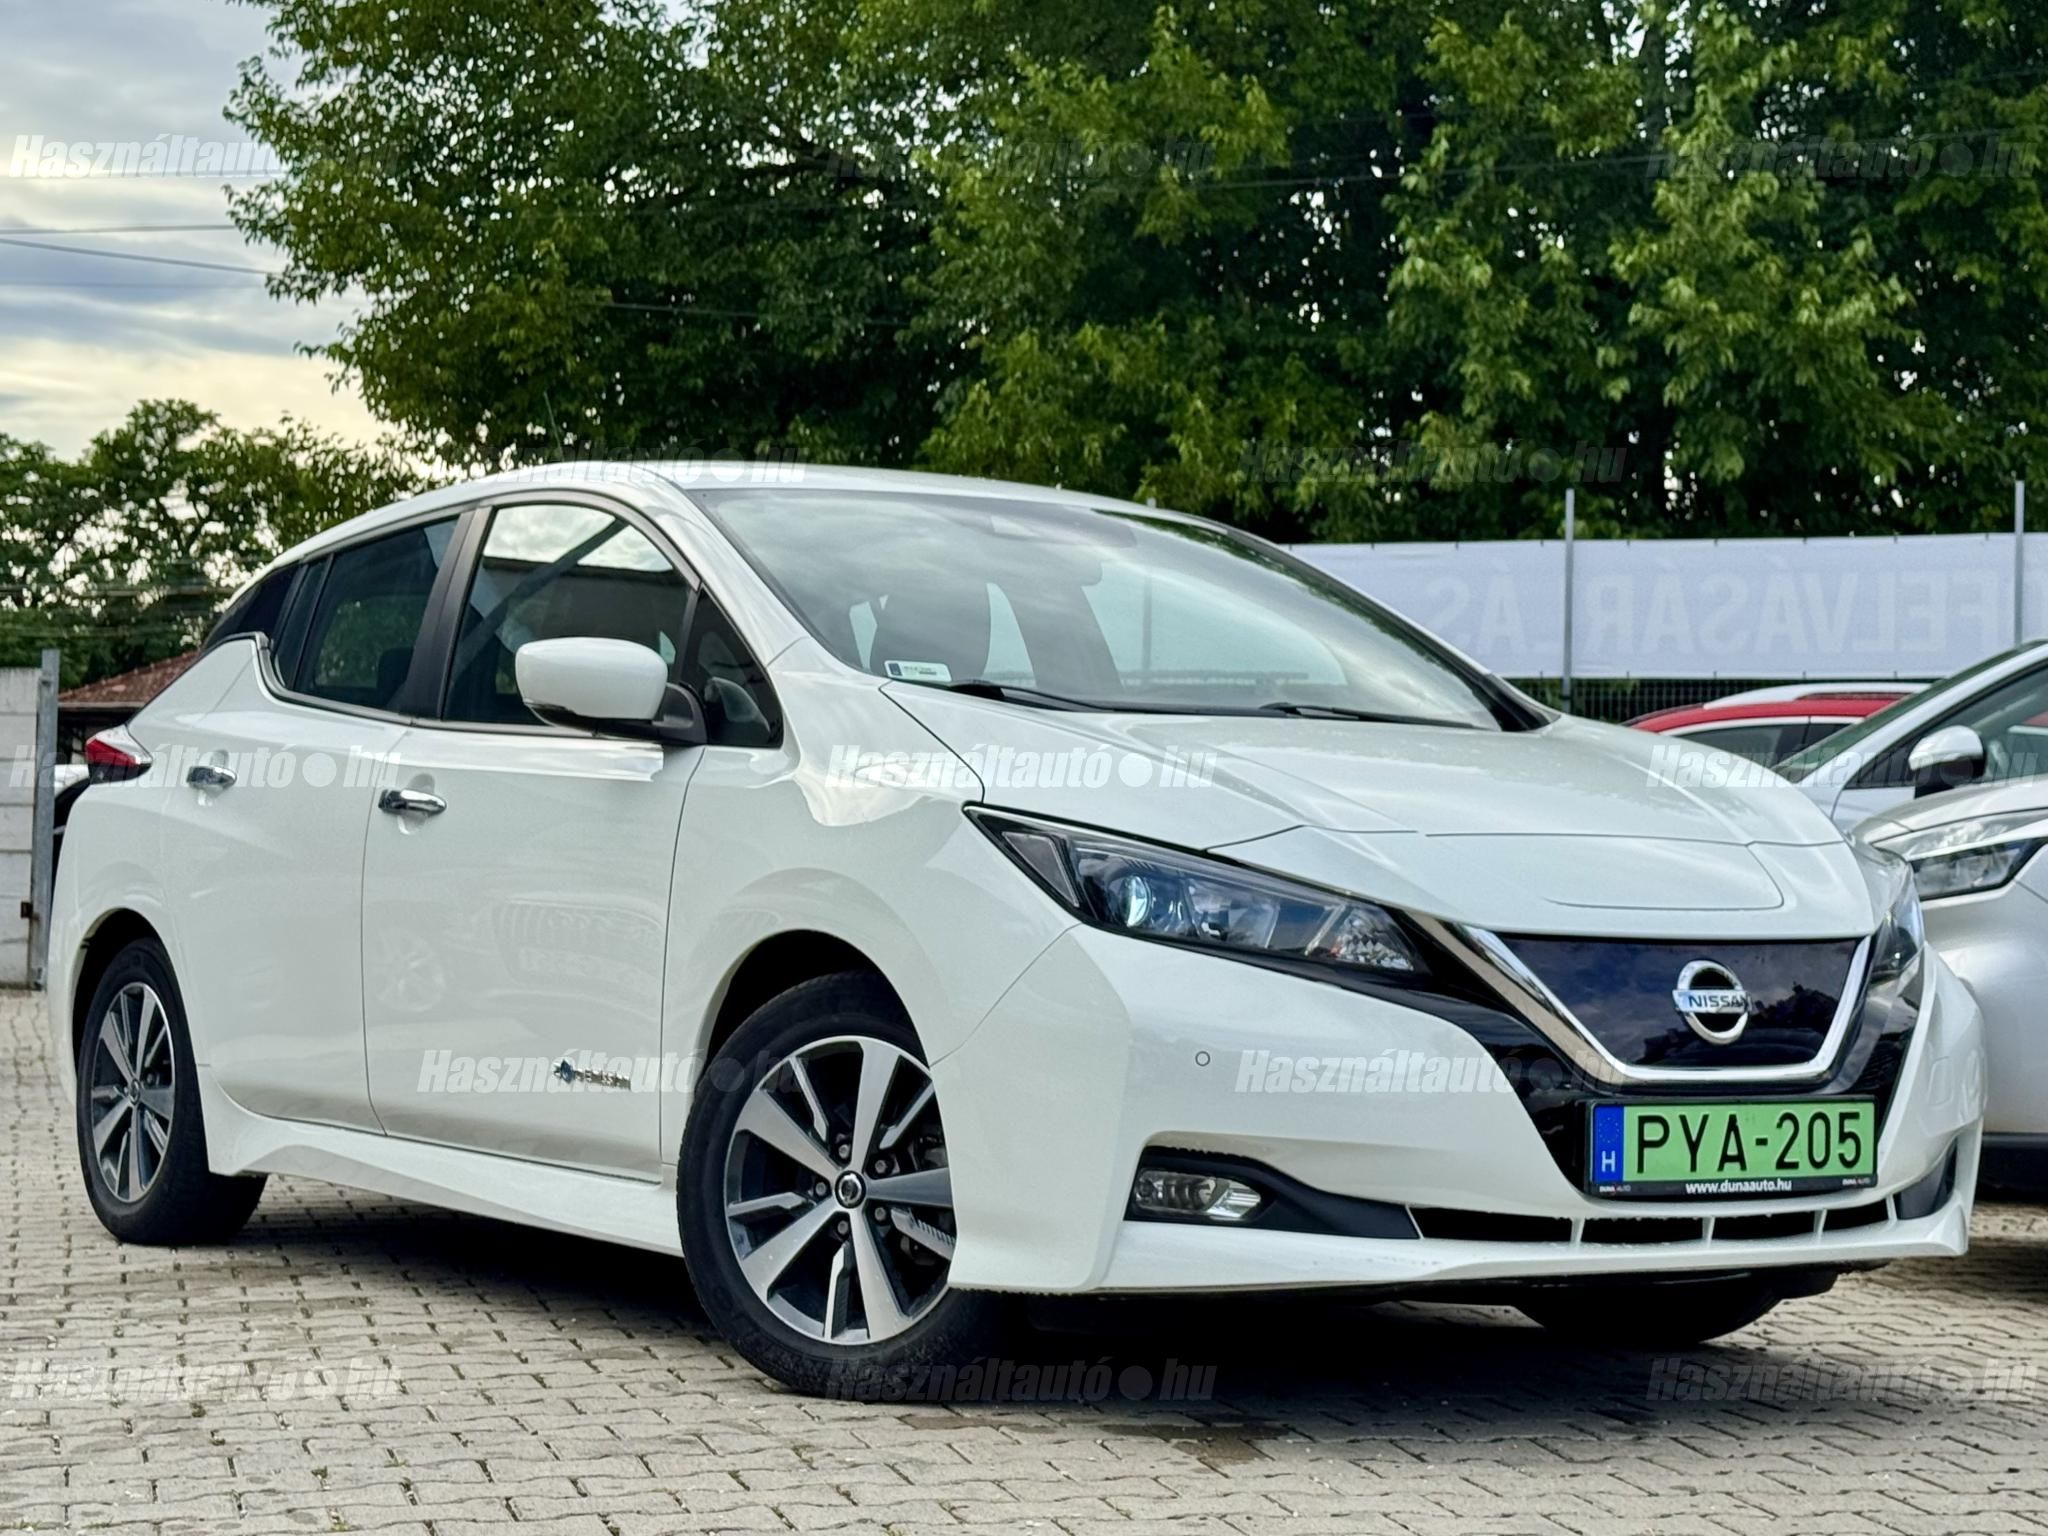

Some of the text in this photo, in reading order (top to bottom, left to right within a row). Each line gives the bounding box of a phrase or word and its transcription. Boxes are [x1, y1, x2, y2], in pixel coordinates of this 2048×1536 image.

[1688, 994, 1748, 1009] NISSAN
[1637, 1111, 1862, 1174] PYA-205
[1601, 1151, 1616, 1173] H
[1686, 1178, 1792, 1193] www.dunaauto.hu
